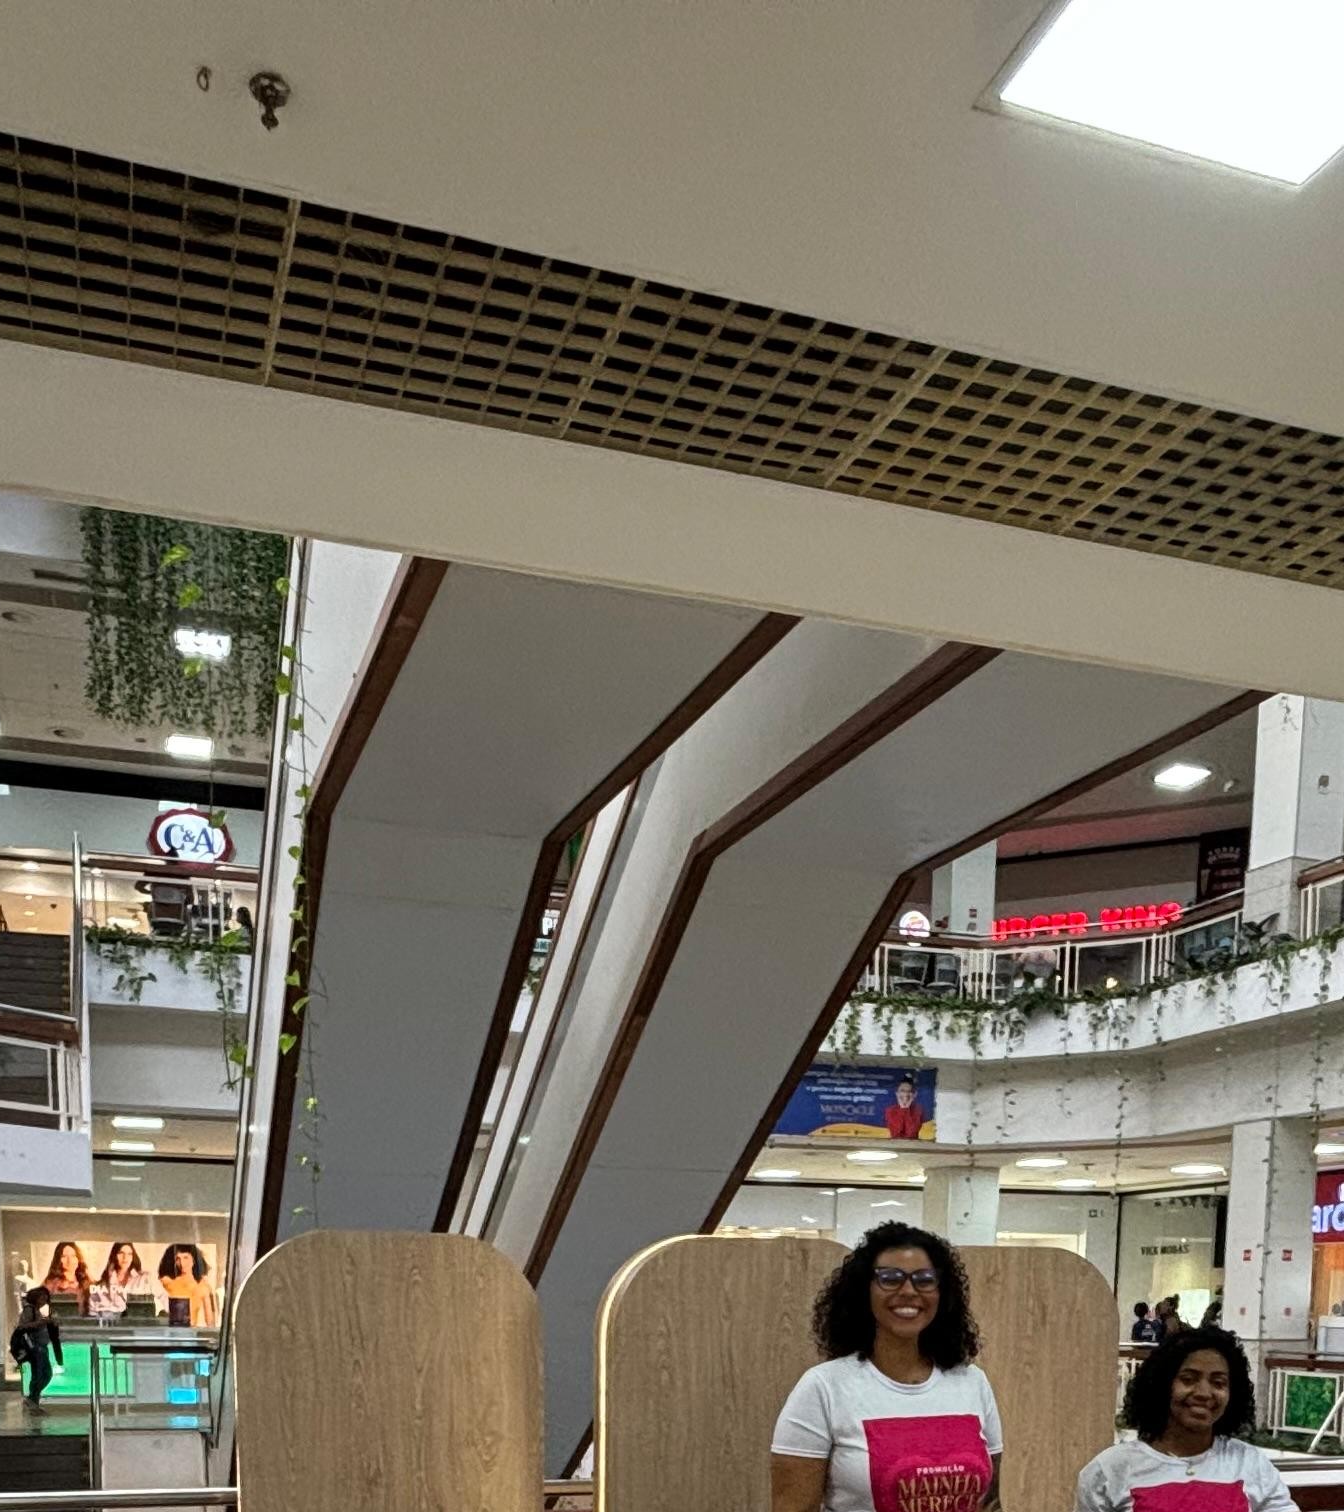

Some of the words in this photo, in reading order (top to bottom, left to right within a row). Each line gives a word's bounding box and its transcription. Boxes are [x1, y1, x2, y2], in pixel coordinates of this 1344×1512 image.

[164, 823, 215, 853] C&A
[991, 911, 1088, 941] URGER
[898, 1474, 982, 1499] MAINHA
